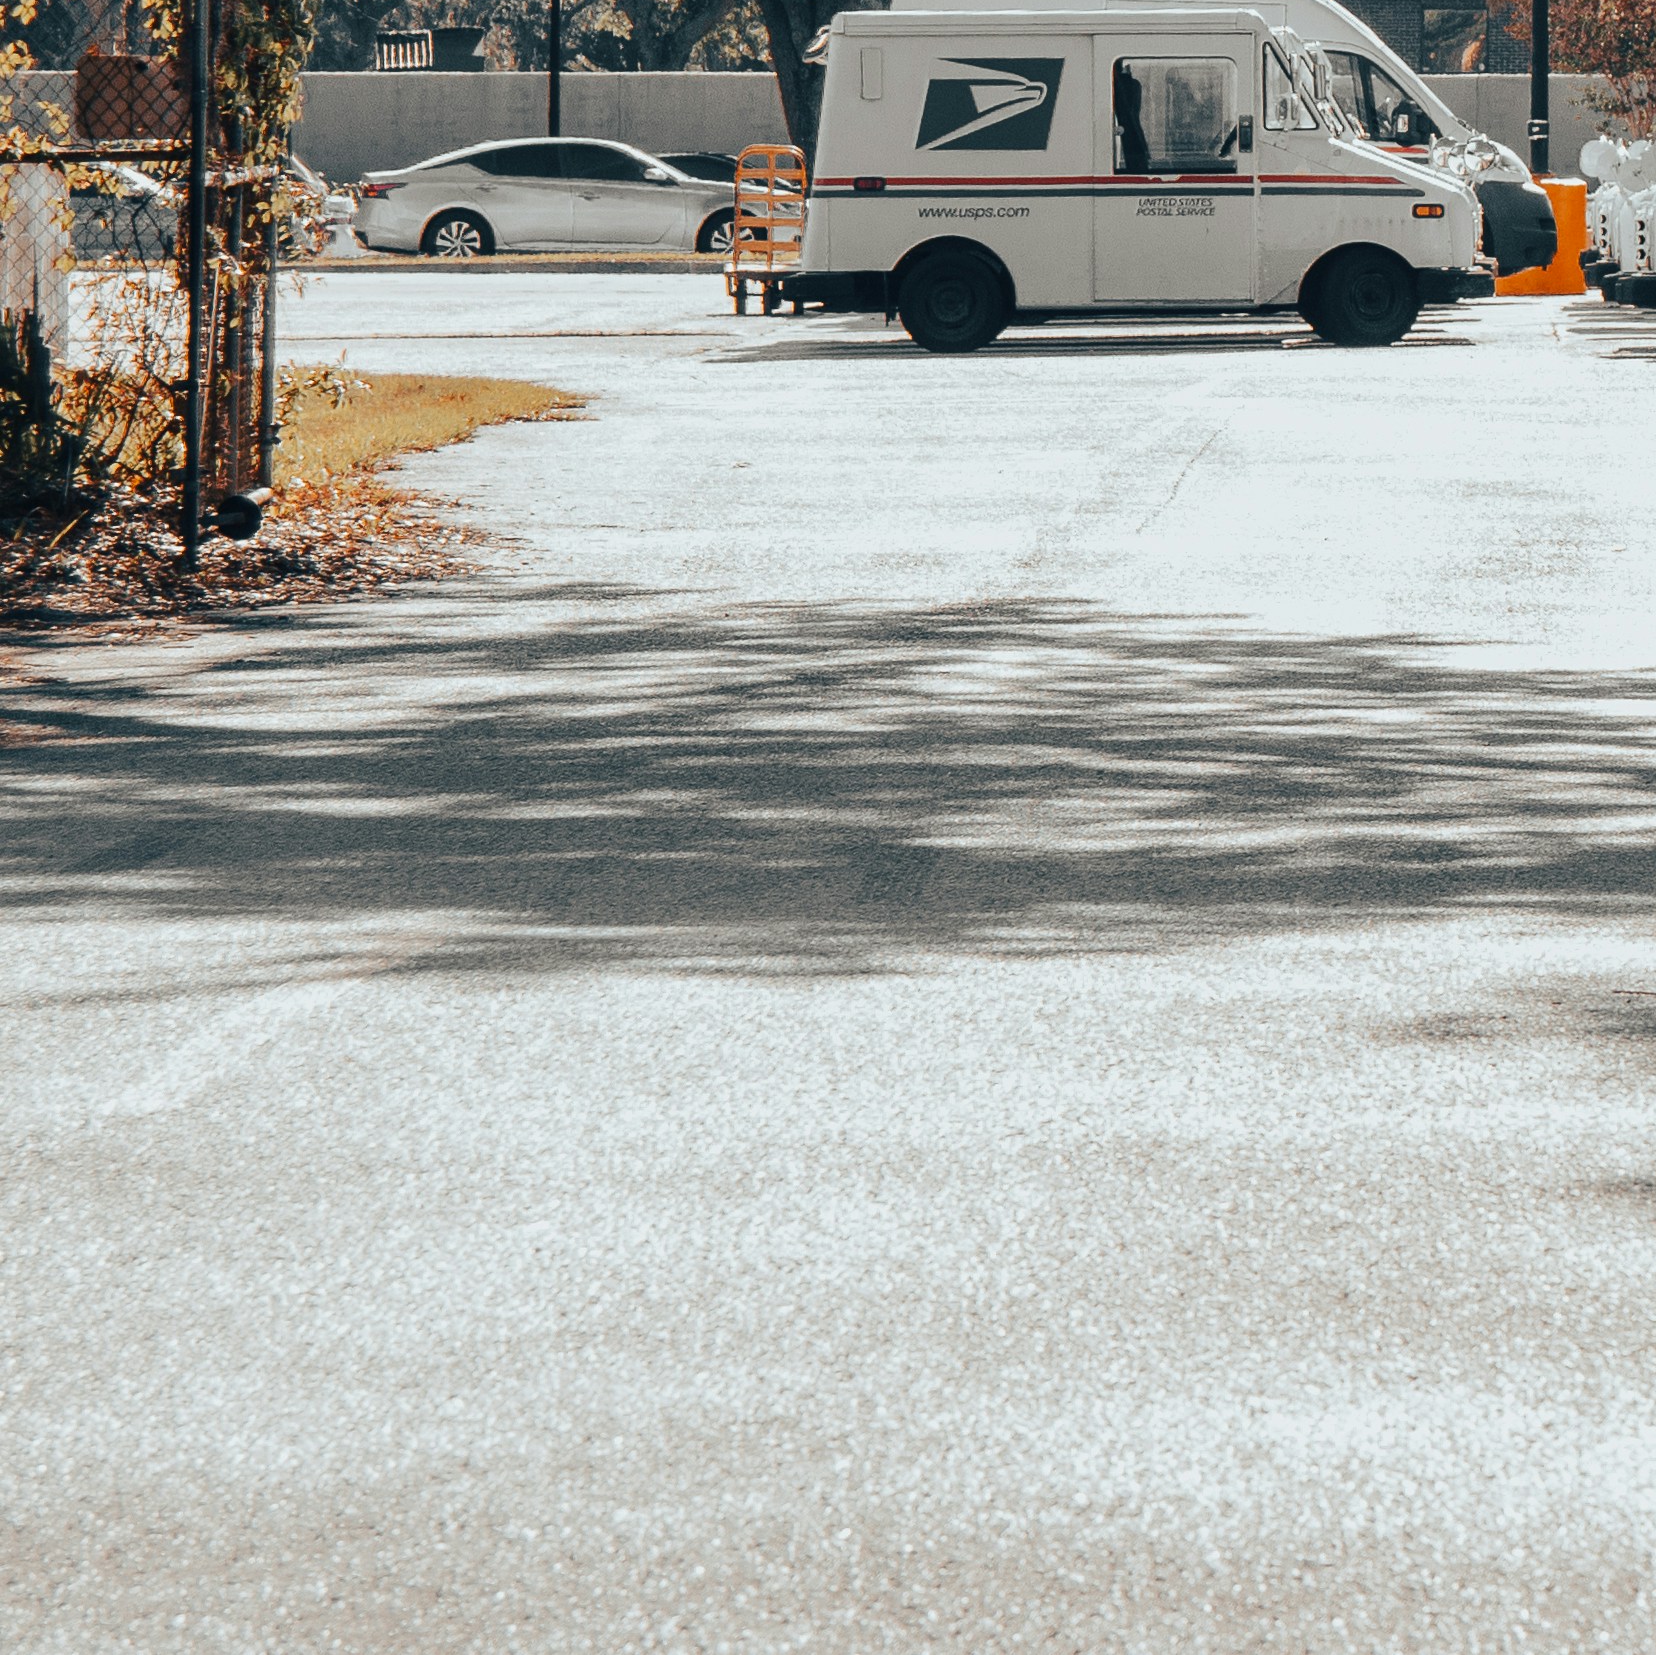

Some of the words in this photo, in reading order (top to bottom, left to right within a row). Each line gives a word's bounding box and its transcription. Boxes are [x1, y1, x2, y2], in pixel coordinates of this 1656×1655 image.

[1138, 198, 1177, 207] UNITED
[1179, 198, 1213, 207] STATES
[918, 207, 1030, 220] www.usps.com
[1136, 207, 1174, 216] POSTAL
[1175, 207, 1216, 216] SERVICE
